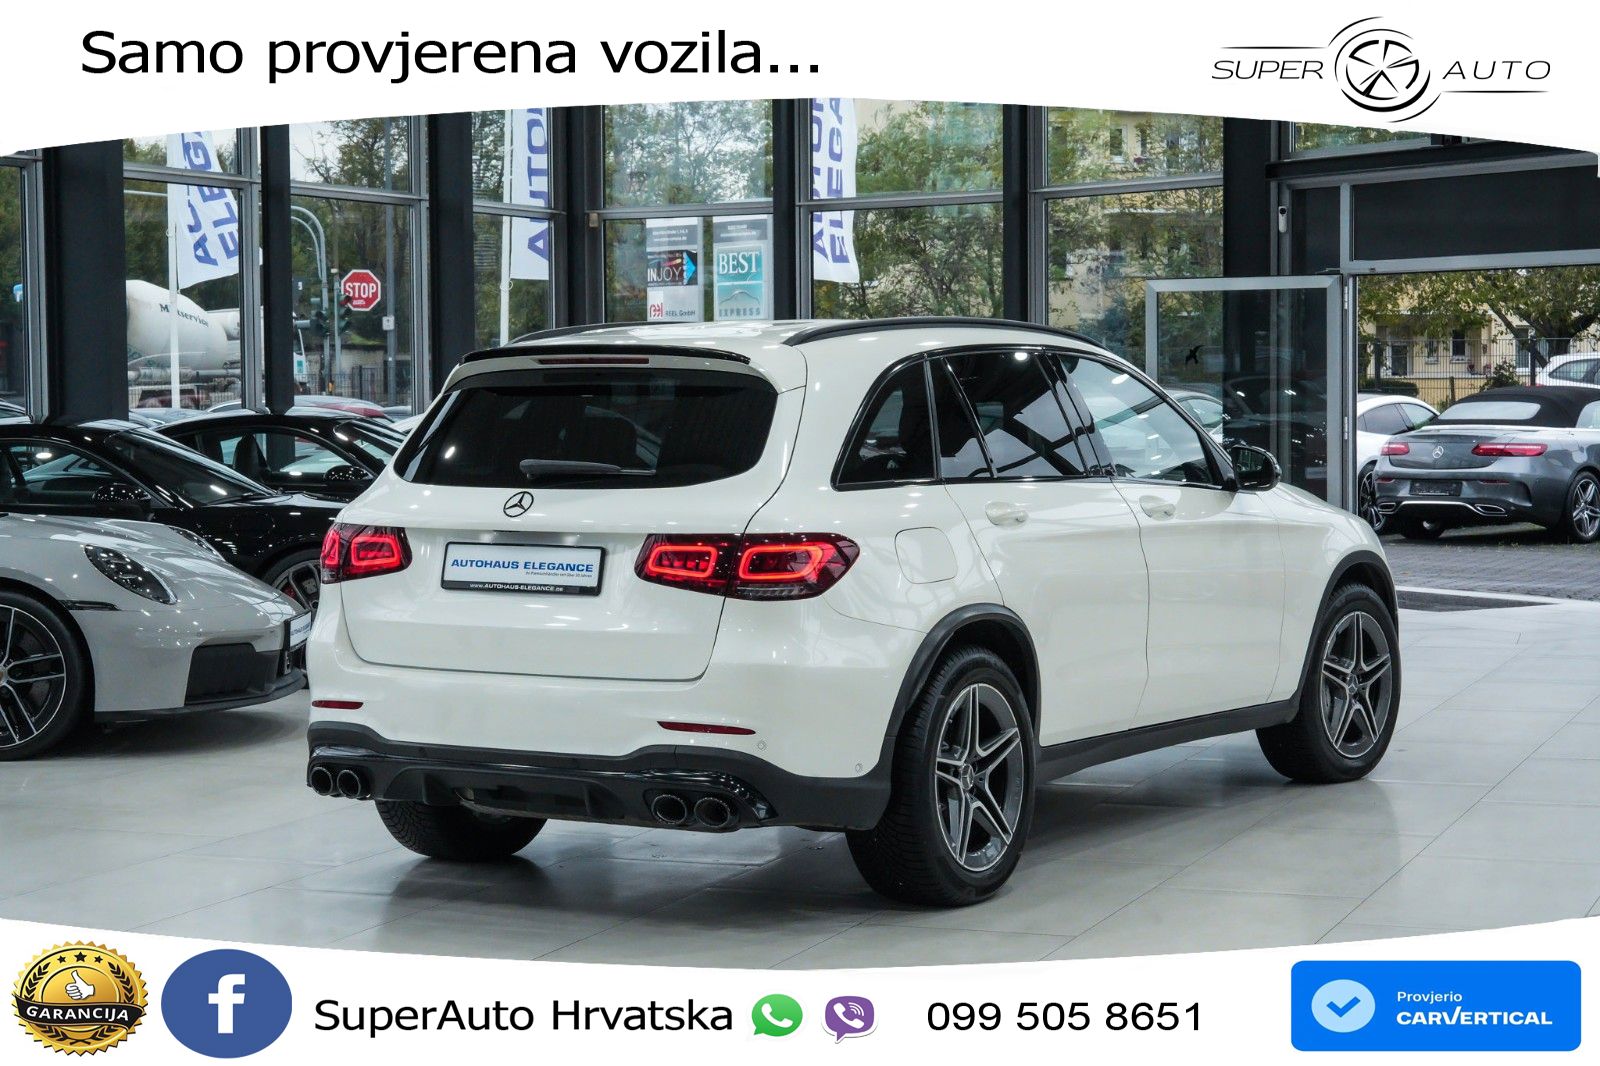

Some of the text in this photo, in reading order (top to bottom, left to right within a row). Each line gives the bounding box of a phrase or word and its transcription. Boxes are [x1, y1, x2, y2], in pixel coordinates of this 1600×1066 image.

[527, 108, 549, 262] AUTO
[719, 251, 761, 275] BEST
[647, 266, 683, 282] INJOY
[345, 282, 377, 299] STOP
[451, 559, 594, 573] AUTOHAUS ELEGANCE
